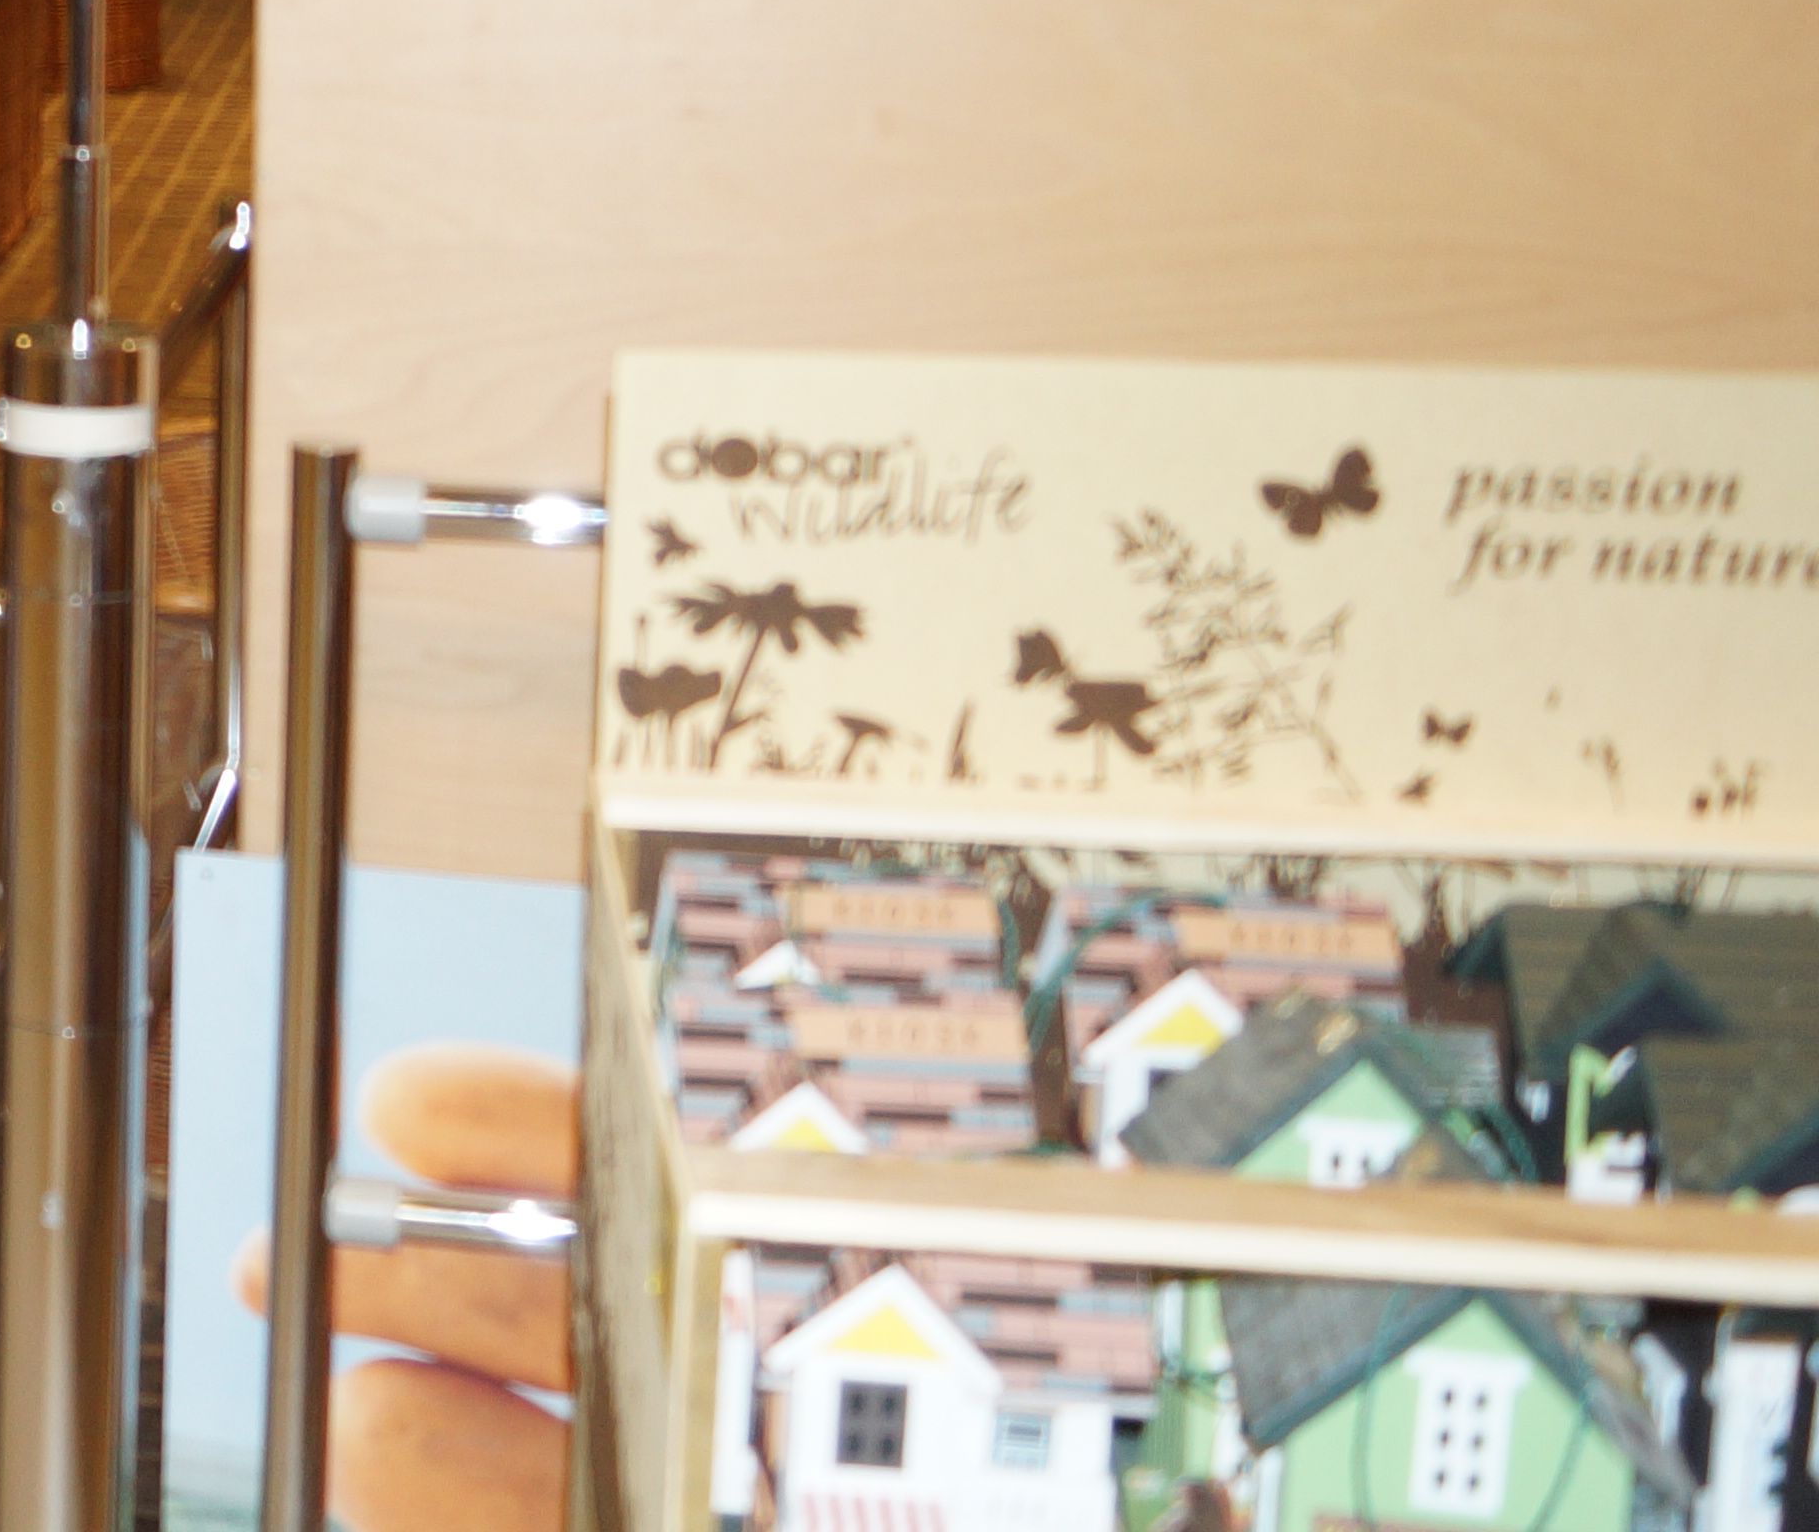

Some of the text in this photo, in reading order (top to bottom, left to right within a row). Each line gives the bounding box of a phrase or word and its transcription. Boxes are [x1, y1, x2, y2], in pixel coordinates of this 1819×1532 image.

[727, 444, 1034, 545] Wildlife
[1443, 453, 1743, 529] passion
[1446, 516, 1574, 599] for
